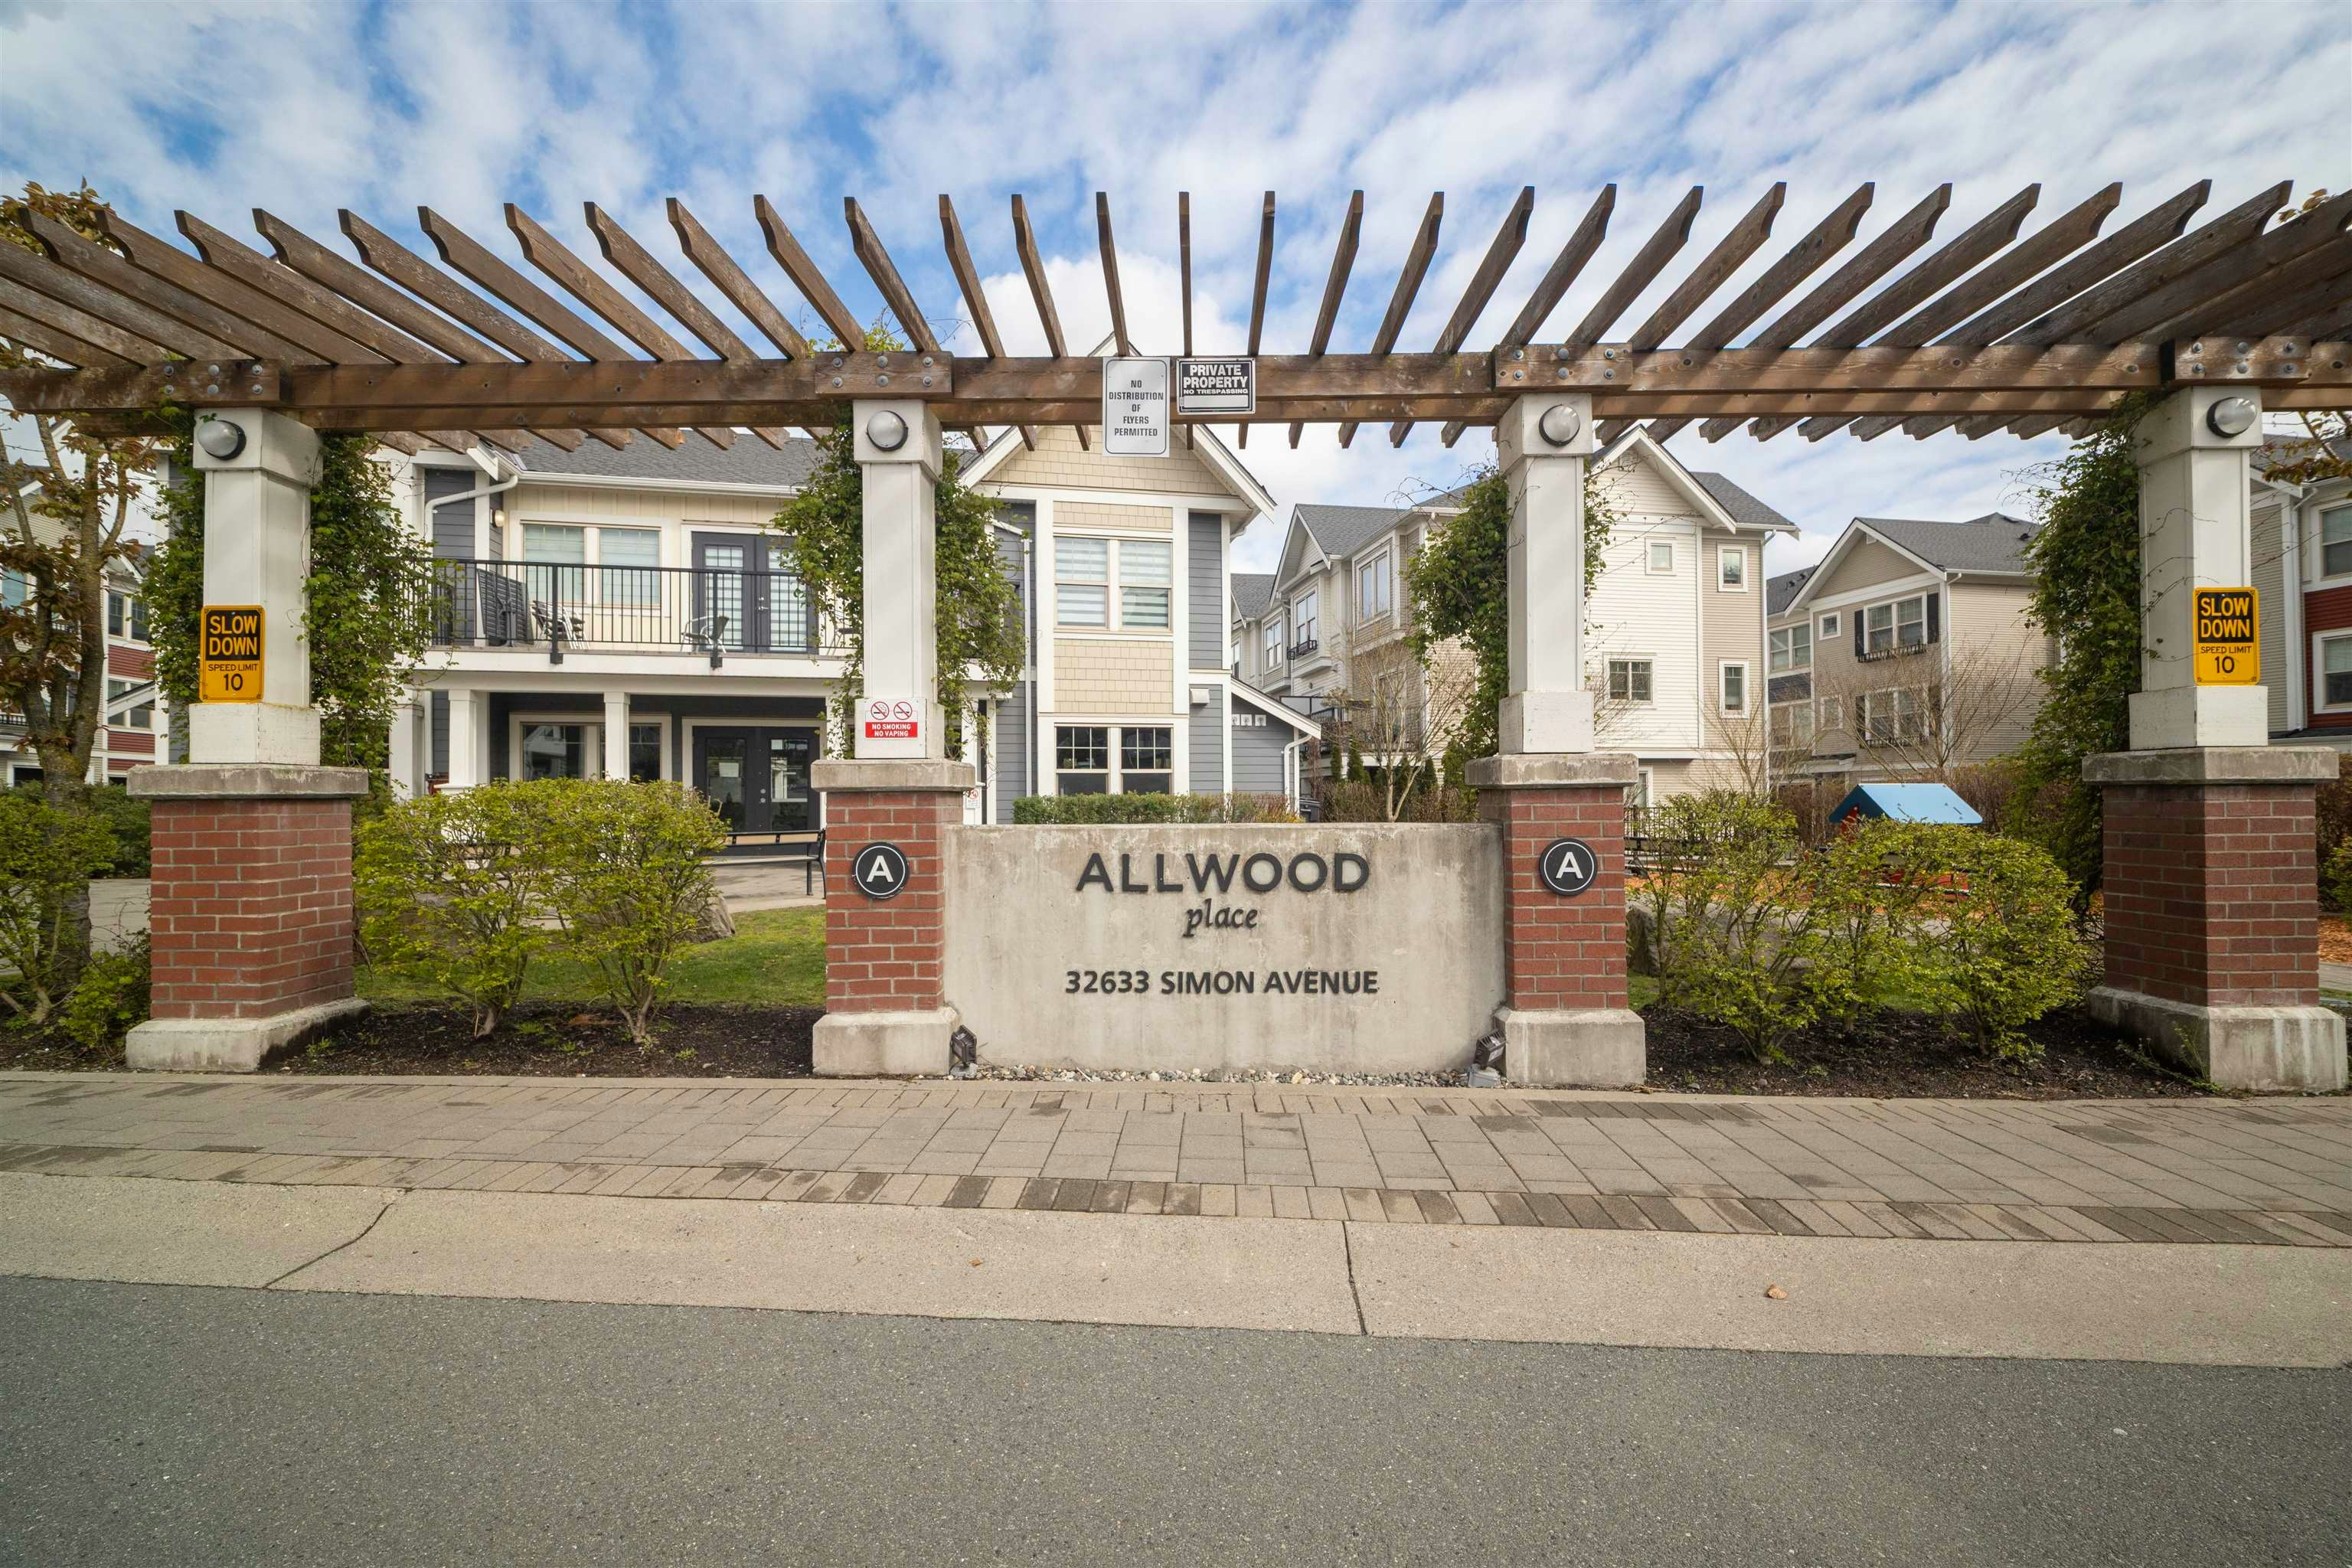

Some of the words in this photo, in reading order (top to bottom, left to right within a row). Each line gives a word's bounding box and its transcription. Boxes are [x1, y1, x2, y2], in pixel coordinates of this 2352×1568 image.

[1190, 364, 1241, 376] PRIVATE
[1131, 380, 1142, 388] NO
[1184, 377, 1248, 388] PROPERTY
[1109, 392, 1164, 400] DISTRIBUTION
[1123, 416, 1149, 424] FLYERS
[1115, 428, 1158, 436] PERMITTED
[2200, 597, 2249, 616] SLOW
[209, 616, 257, 634] SLOW
[2200, 619, 2250, 638] DOWN
[209, 637, 257, 655] DOWN
[2229, 645, 2252, 654] LIMIT
[238, 663, 258, 671] LIMIT
[2214, 655, 2235, 674] 10
[224, 673, 243, 691] 10
[866, 854, 894, 883] A
[1076, 852, 1370, 893] ALLWOOD
[1555, 851, 1584, 879] A
[1181, 898, 1259, 938] place
[1065, 970, 1149, 994] 32633
[1161, 970, 1255, 995] SIMON
[1264, 971, 1378, 995] AVENUE
